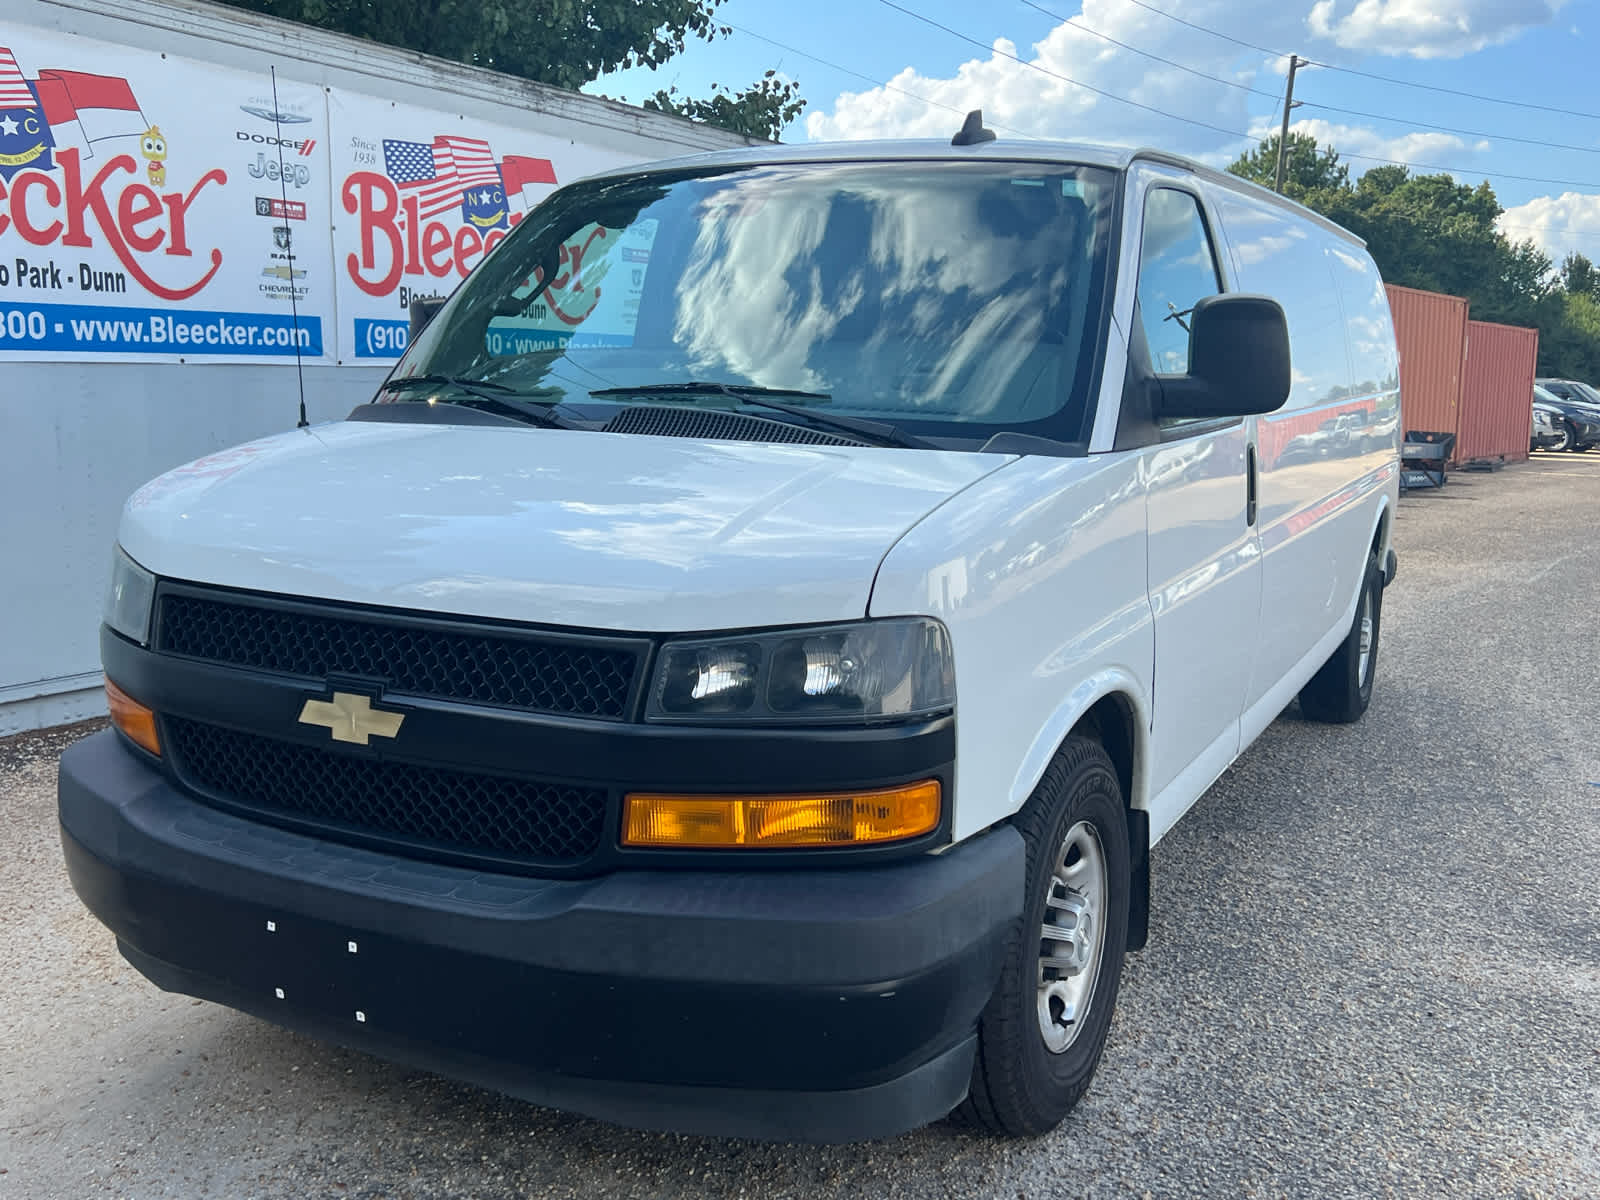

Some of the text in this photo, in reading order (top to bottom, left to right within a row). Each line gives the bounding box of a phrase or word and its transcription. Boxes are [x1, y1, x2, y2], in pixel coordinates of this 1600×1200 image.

[236, 131, 305, 150] DODGE
[247, 152, 310, 188] Jeep
[270, 252, 297, 261] RAM
[15, 258, 63, 289] Park
[79, 262, 127, 293] Dunn
[70, 315, 311, 348] www.Bleecker.com
